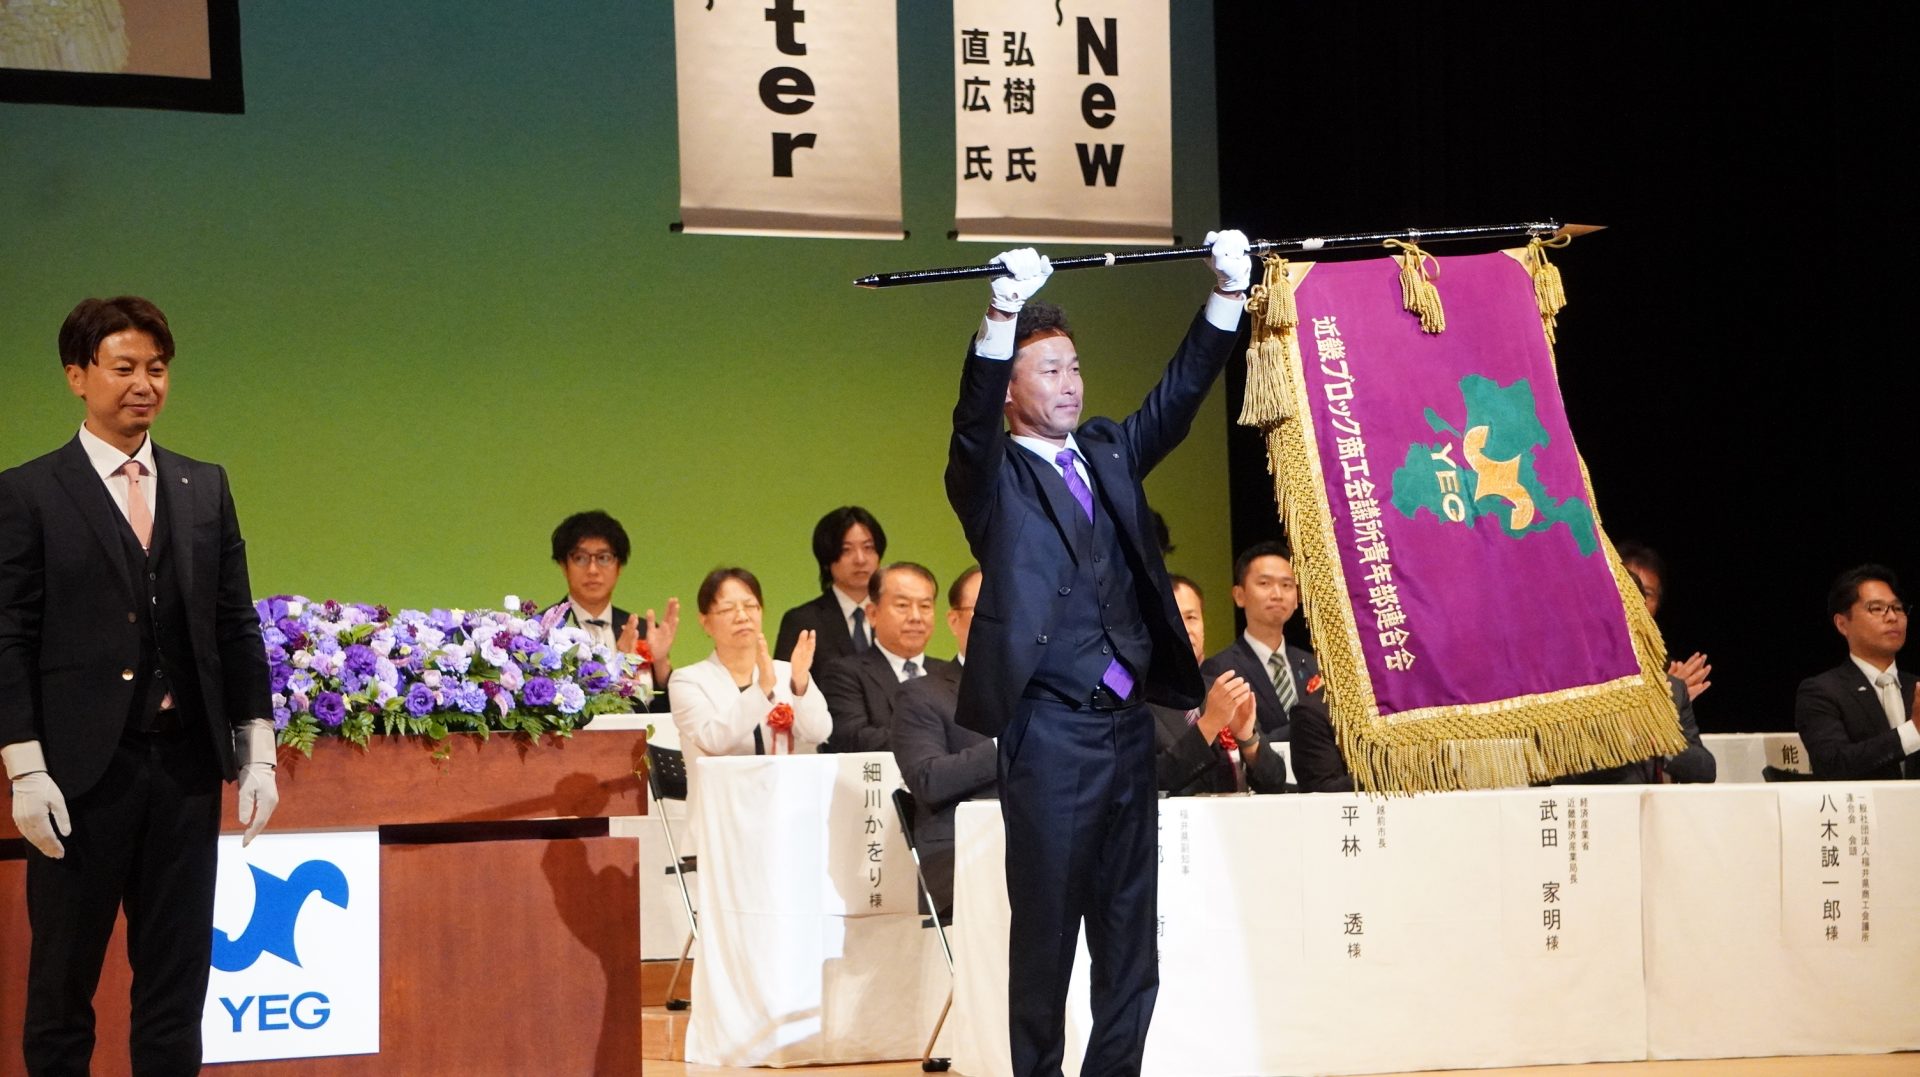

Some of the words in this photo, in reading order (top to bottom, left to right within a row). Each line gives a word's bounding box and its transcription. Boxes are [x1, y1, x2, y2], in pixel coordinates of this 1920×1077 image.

[960, 28, 991, 114] 直広
[1003, 31, 1036, 115] 弘樹
[1075, 16, 1125, 187] New
[963, 145, 993, 182] 氏
[1006, 146, 1037, 183] 氏
[1311, 315, 1417, 672] 近畿ブロック商工会議所青年部連合会
[1430, 441, 1466, 523] YEG
[862, 761, 884, 909] 細川かをり様
[1341, 804, 1362, 858] 平林
[1539, 798, 1559, 849] 武田
[1819, 793, 1842, 942] 八木誠一郎様
[1542, 880, 1562, 952] 家明様
[218, 990, 331, 1033] YEG
